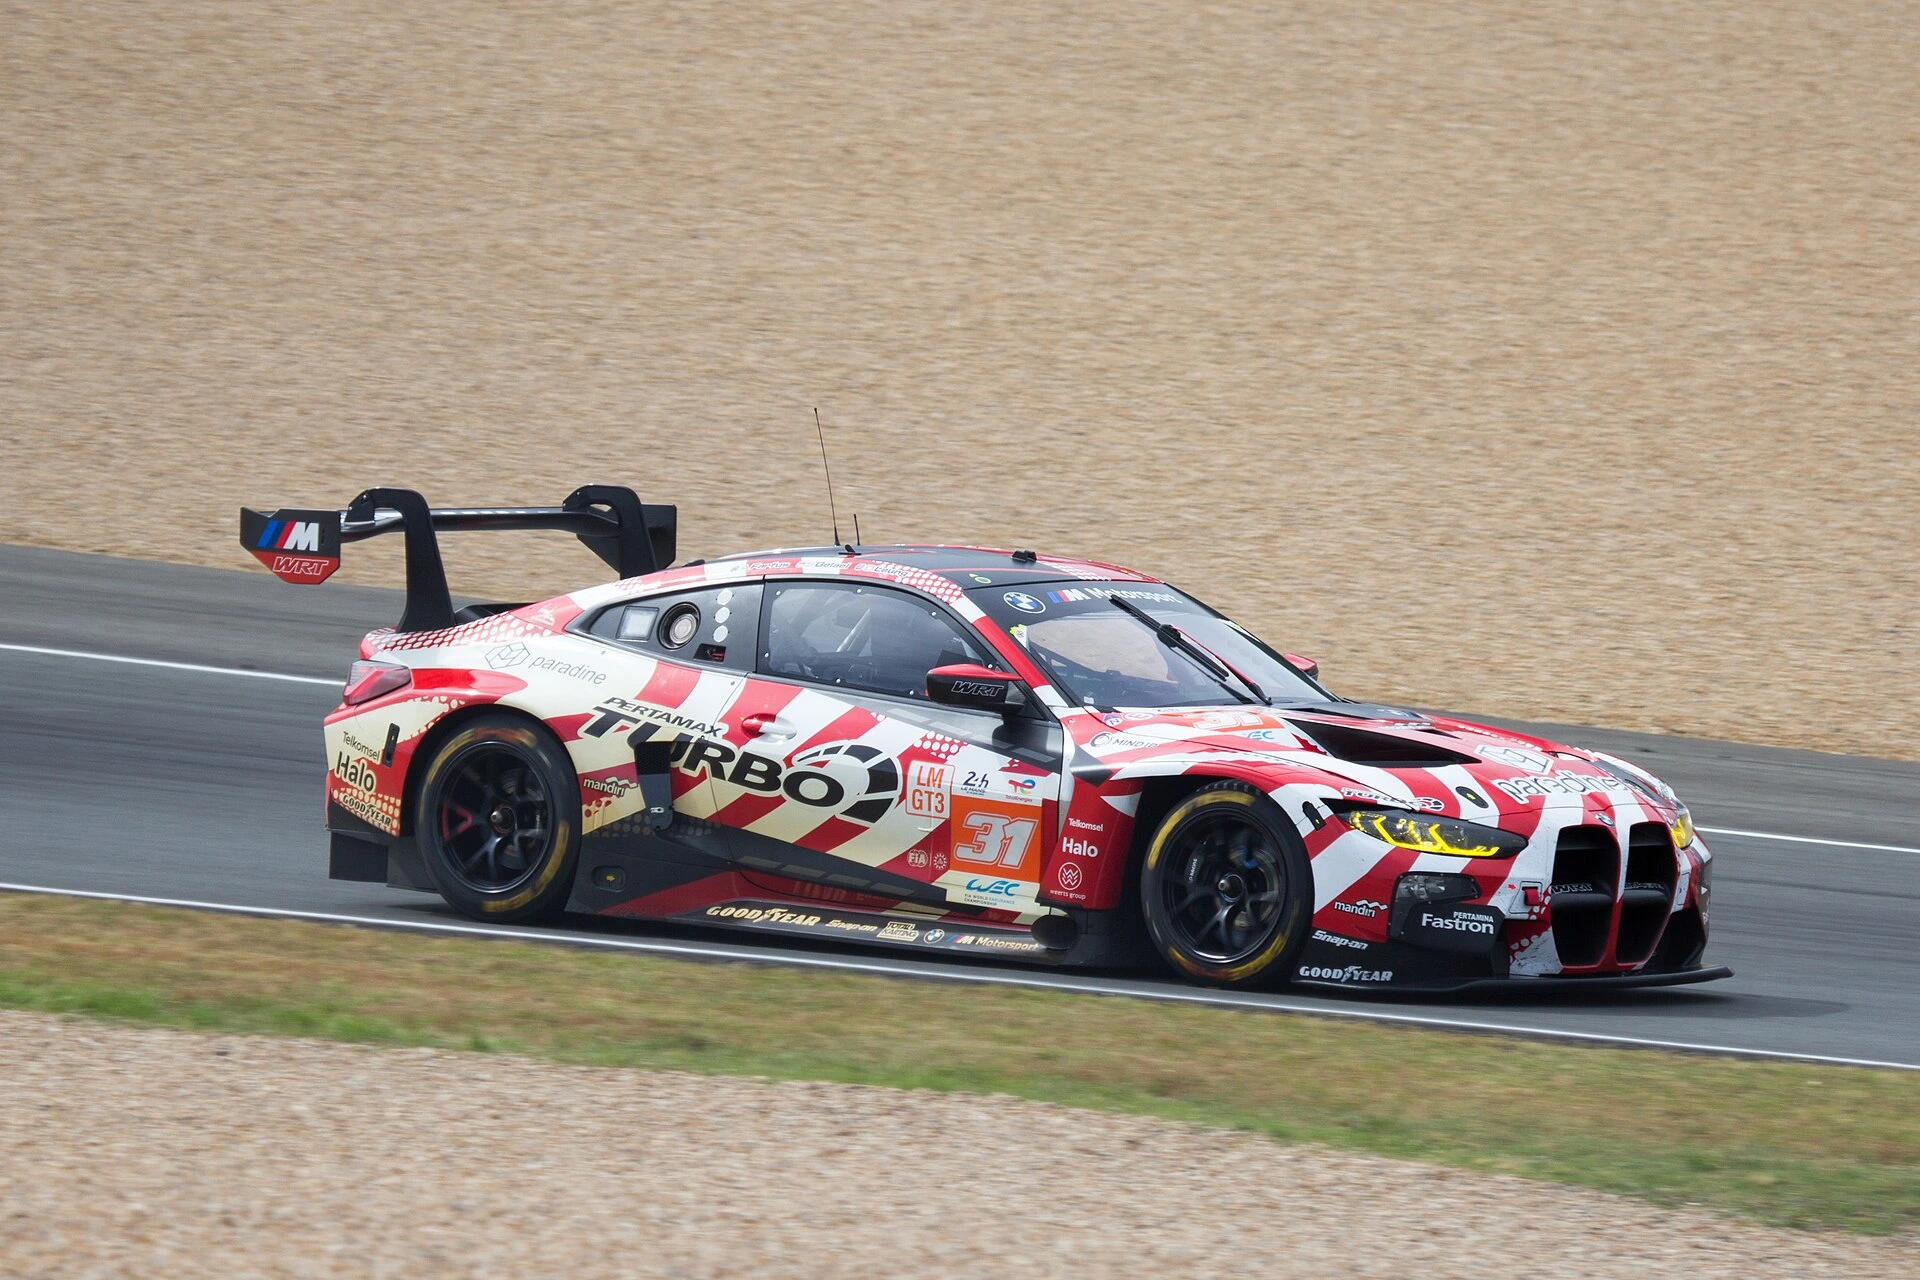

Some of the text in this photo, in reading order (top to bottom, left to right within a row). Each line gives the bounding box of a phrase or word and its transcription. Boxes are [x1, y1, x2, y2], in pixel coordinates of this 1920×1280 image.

[272, 556, 329, 576] WRT
[530, 652, 608, 686] paradine
[951, 681, 1004, 697] WRT
[602, 696, 723, 738] PERTAMAX
[342, 731, 381, 762] Telkomsel
[583, 706, 845, 808] TURBO
[336, 751, 376, 793] Halo
[917, 766, 945, 788] LM
[583, 777, 626, 798] mandiri
[1497, 770, 1624, 802] paradine
[342, 792, 392, 828] GOODYEAR
[912, 788, 945, 814] GT3
[1068, 818, 1104, 832] Telkomsel
[954, 811, 1039, 870] 31
[1062, 836, 1099, 858] Halo
[965, 878, 1020, 896] WEC
[1069, 892, 1086, 900] group
[706, 906, 822, 928] GOODYEAR
[1334, 900, 1376, 919] mandiri
[1453, 911, 1494, 923] PERTAMINA
[1421, 913, 1495, 935] Fastron
[976, 937, 1039, 951] Motorsport
[1312, 930, 1369, 950] Snap-on
[1299, 965, 1394, 983] GOODYEAR
